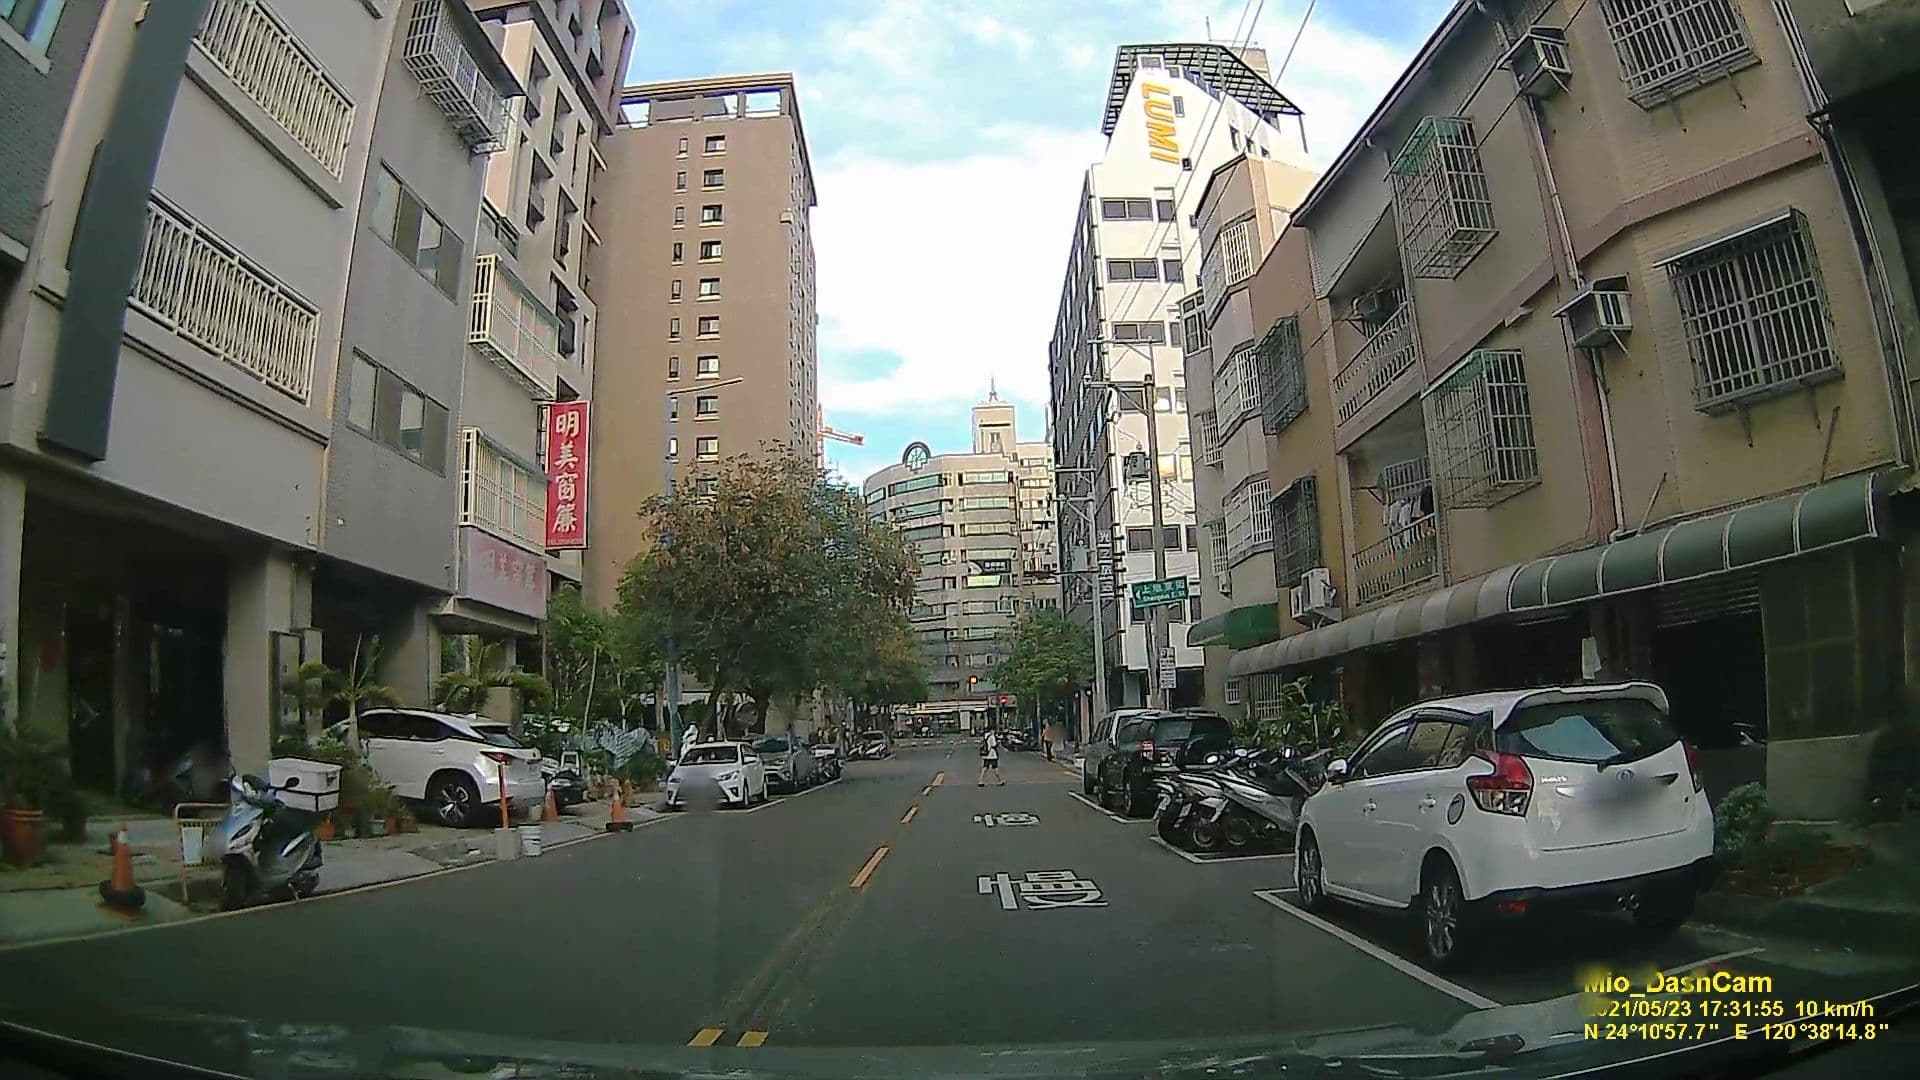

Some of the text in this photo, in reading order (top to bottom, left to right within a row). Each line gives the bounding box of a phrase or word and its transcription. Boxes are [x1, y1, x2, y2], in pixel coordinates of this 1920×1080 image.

[1142, 83, 1180, 165] LUMI
[553, 410, 580, 533] 明美窗簾
[978, 870, 1109, 910] 慢
